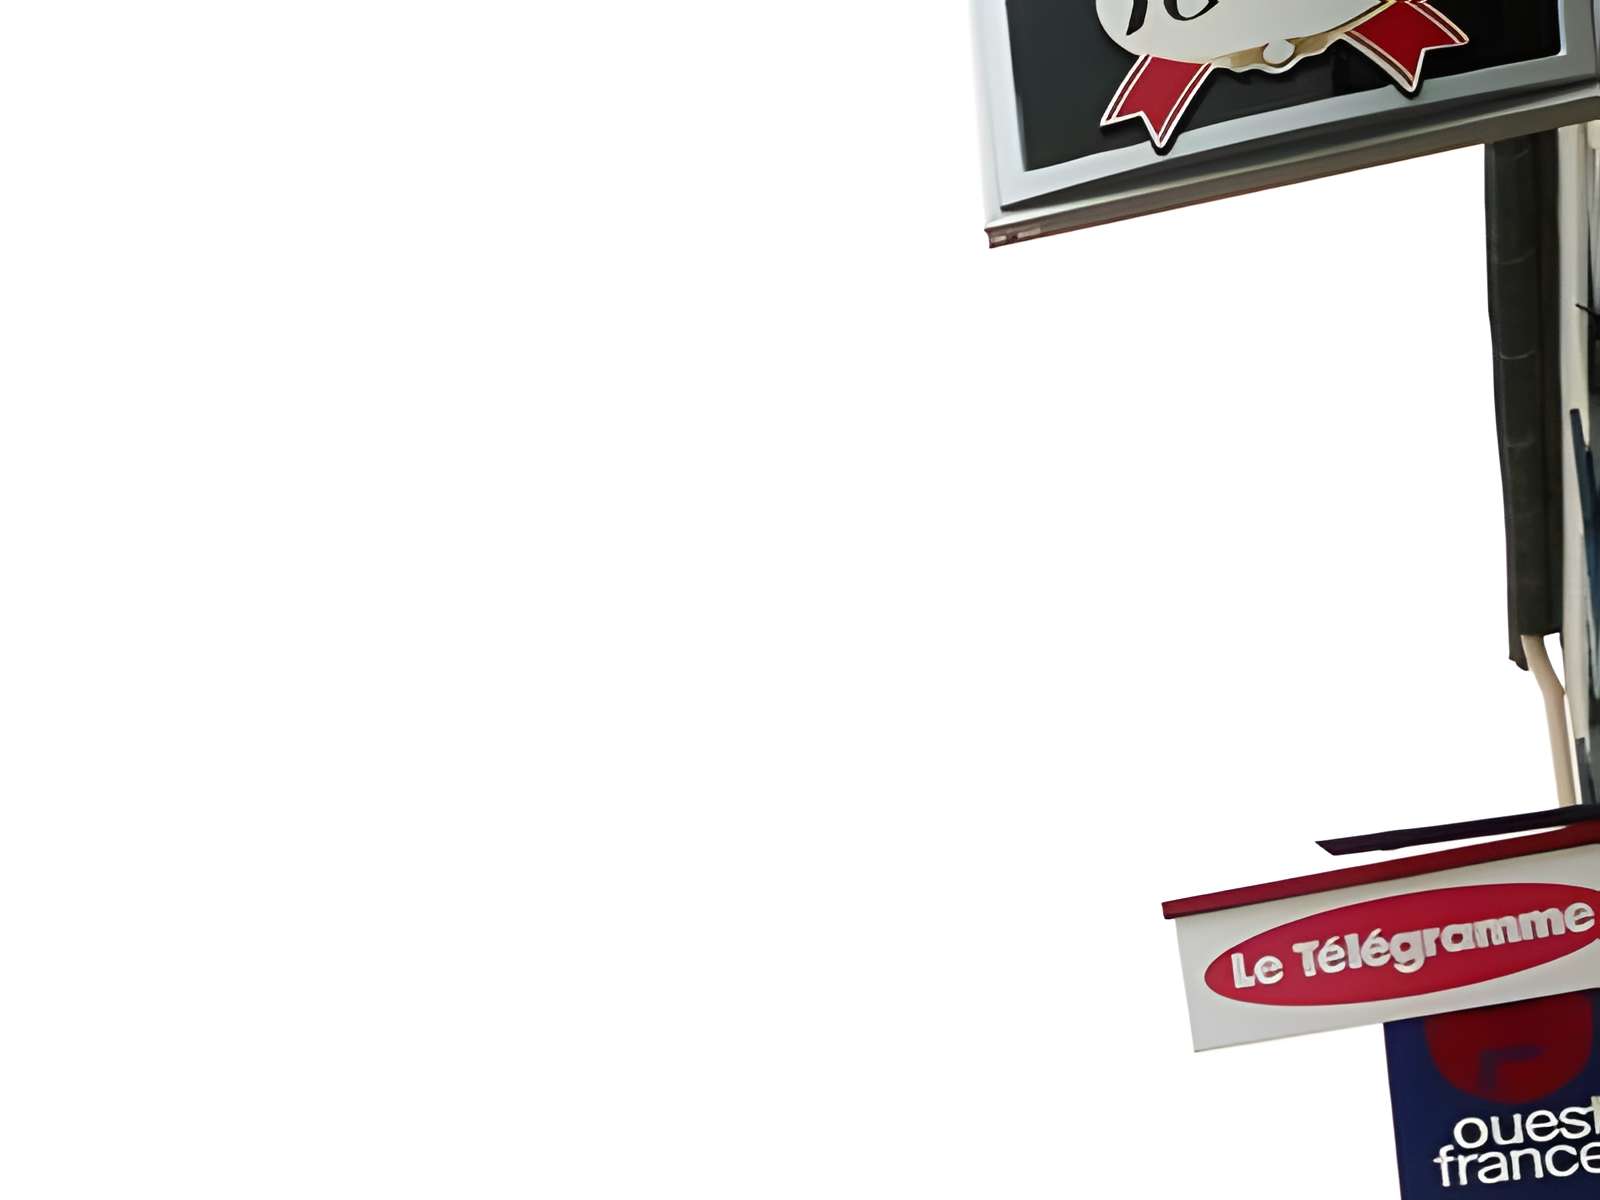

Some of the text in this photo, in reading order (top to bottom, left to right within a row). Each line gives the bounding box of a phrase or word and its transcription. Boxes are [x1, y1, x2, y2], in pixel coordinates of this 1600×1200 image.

[1230, 901, 1596, 989] Le Télégramme
[1433, 1142, 1600, 1188] france
